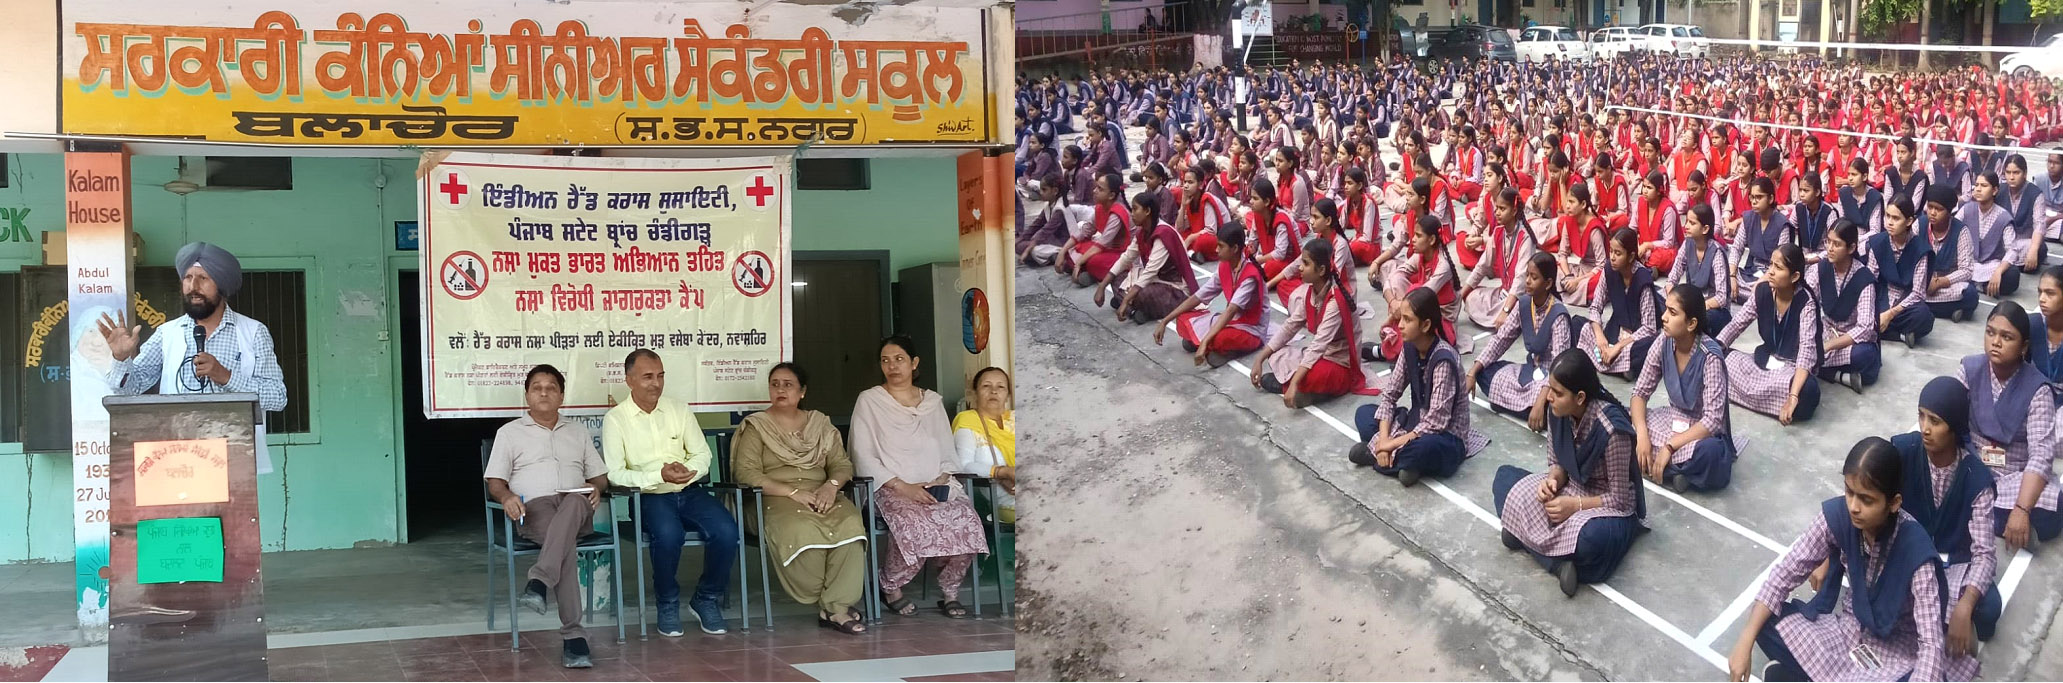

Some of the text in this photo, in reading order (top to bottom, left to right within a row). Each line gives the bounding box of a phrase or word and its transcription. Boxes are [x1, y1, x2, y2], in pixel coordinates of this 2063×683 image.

[75, 10, 304, 97] ਸਰਕਾਰੀ
[490, 19, 667, 101] ਸੀਨੀਅਰ
[674, 18, 834, 103] ਸੈਕੰਡਰੀ
[839, 41, 967, 121] ਸਕੂਲ
[69, 170, 119, 192] Kalam
[482, 183, 558, 209] ਇੰਡੀਅਨ
[607, 192, 651, 209] ਕਰਾਸ
[69, 201, 121, 223] House
[508, 217, 553, 241] ਪੰਜਾਬ
[562, 218, 598, 241] ਸਟੇਟ
[78, 268, 109, 278] Abdul
[492, 245, 725, 279] ਨਸ਼ਾ ਮੁਕਤ ਭਾਰਤ ਅਭਿਆਨ ਤਹਿਤ
[79, 284, 112, 294] Kalam
[515, 290, 544, 314] ਨਸ਼ਾ
[496, 336, 521, 349] ਕਰਾਸ
[526, 336, 545, 350] ਨਸ਼ਾ
[584, 331, 604, 348] ਲਈ
[669, 329, 693, 347] ਵਸੇਬਾ
[75, 442, 88, 456] 15
[76, 488, 94, 502] 27
